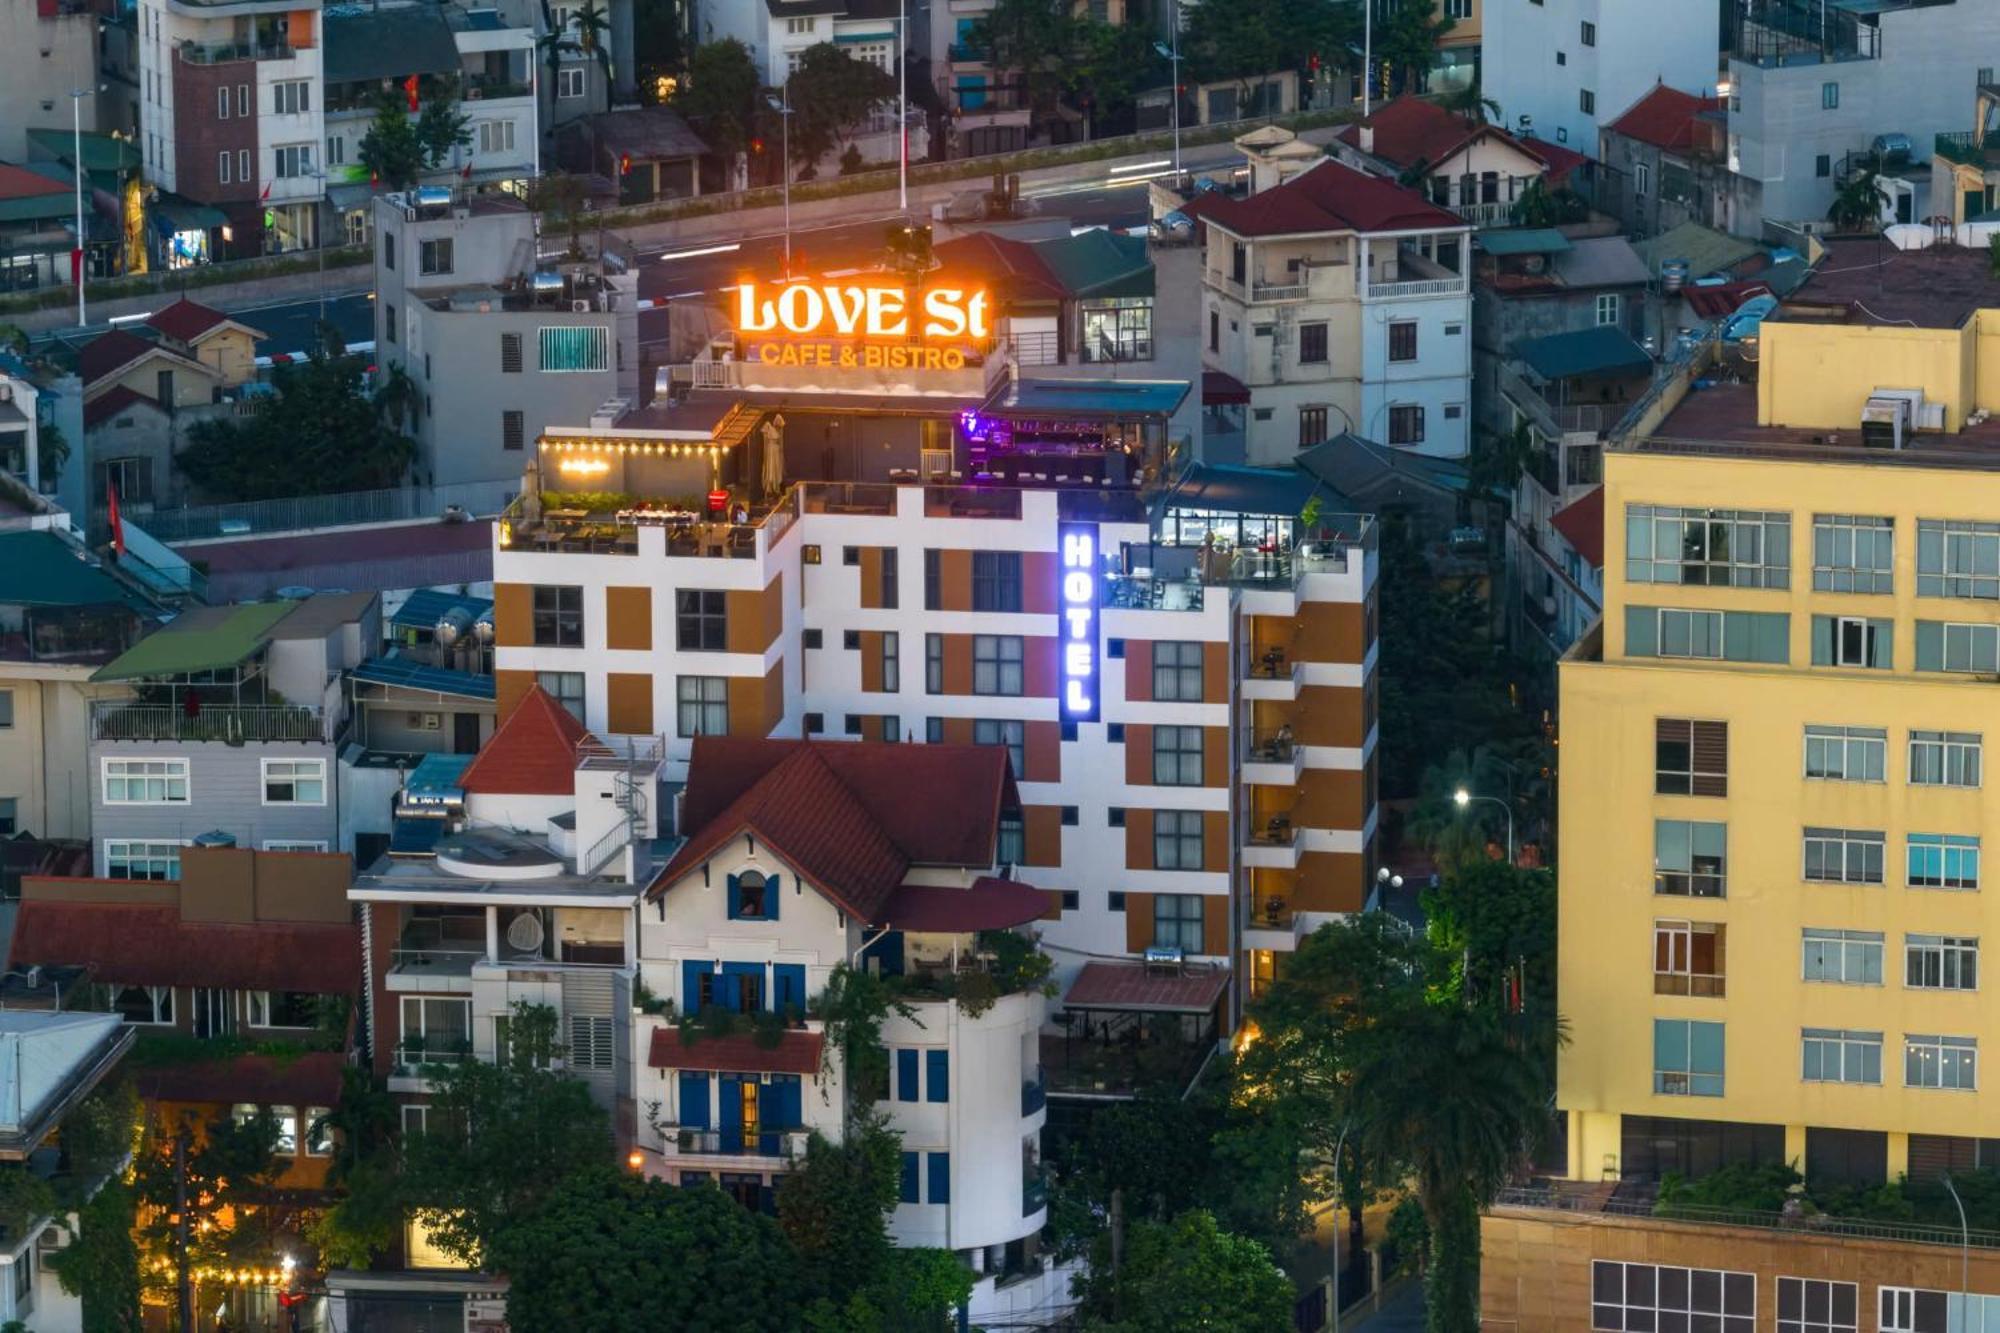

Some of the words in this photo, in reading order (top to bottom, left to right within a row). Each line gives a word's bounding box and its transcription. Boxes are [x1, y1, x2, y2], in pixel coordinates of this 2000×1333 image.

[740, 284, 908, 336] LOVE
[925, 289, 988, 338] St
[760, 343, 832, 368] CAFE
[839, 345, 858, 368] &
[865, 346, 965, 370] BISTRO
[1064, 534, 1093, 711] HOTEL
